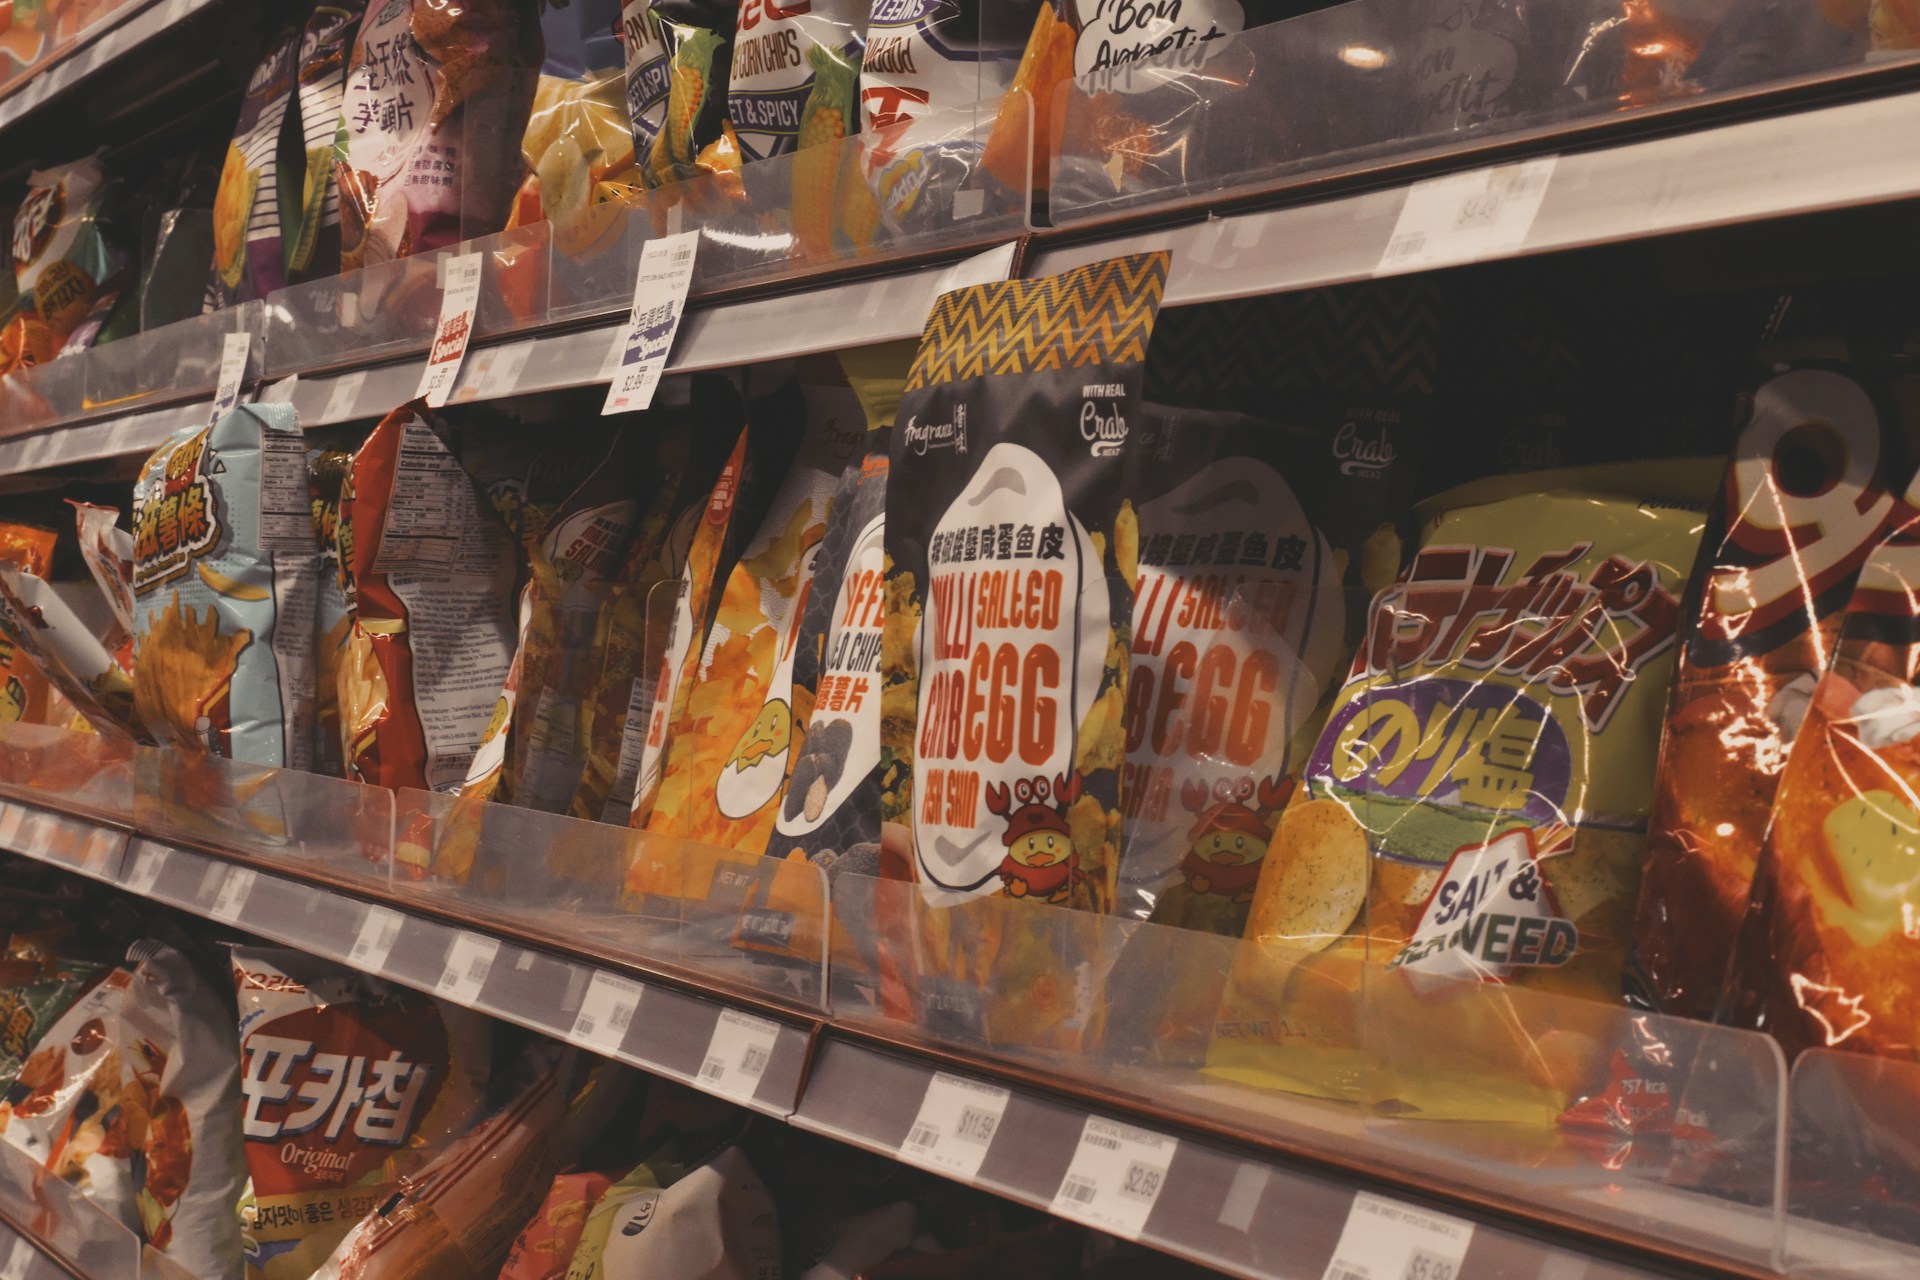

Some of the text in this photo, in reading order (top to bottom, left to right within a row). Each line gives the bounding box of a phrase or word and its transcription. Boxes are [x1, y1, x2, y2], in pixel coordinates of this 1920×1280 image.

[1108, 0, 1183, 35] Bon
[354, 33, 415, 92] 全天然
[762, 28, 802, 74] CHIPS
[1083, 26, 1226, 96] Appetit
[352, 93, 415, 135] 芋頭片
[749, 102, 760, 125] &
[758, 100, 801, 127] SPICY
[1083, 384, 1126, 398] WITH REAL
[1080, 400, 1129, 441] Crab
[265, 443, 292, 451] Calories
[401, 460, 426, 468] Calories
[1102, 447, 1121, 457] MEAT
[1332, 422, 1397, 464] Crab
[976, 569, 1064, 631] SALTED
[962, 641, 1061, 767] EGG
[1150, 640, 1281, 768] EGG
[1332, 698, 1541, 810] のり塩
[1435, 858, 1540, 926] SALT &
[242, 1033, 433, 1142] 포카칩
[281, 1142, 355, 1174] Original
[1124, 1165, 1160, 1197] $2.69
[304, 1201, 334, 1224] 좋은
